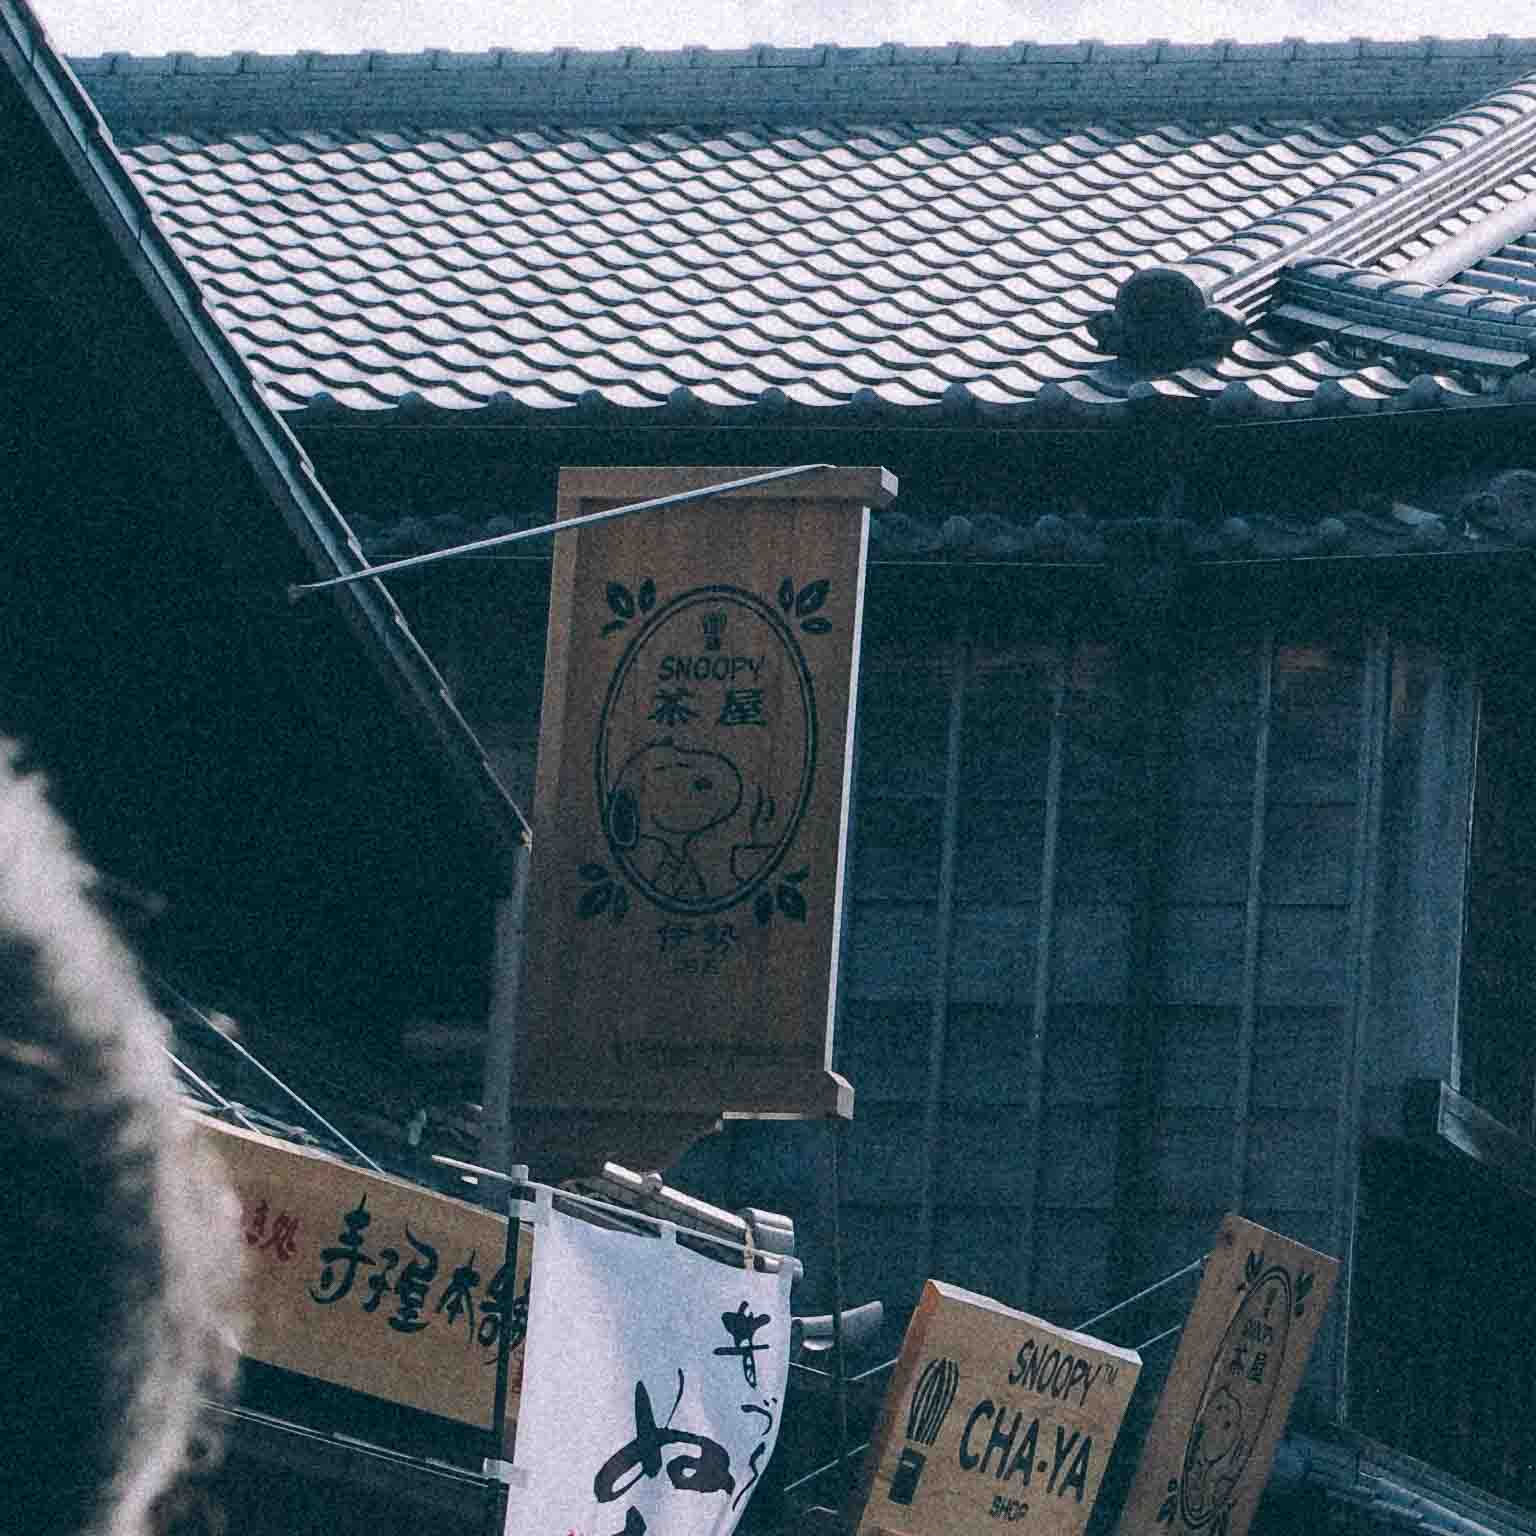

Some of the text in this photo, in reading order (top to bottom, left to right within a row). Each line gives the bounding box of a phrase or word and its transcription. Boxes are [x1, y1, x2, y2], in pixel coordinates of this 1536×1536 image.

[658, 655, 767, 681] SNOOPY
[647, 688, 768, 728] 茶屋
[1007, 1339, 1101, 1408] SNOOPY
[989, 1495, 1030, 1522] SHOP
